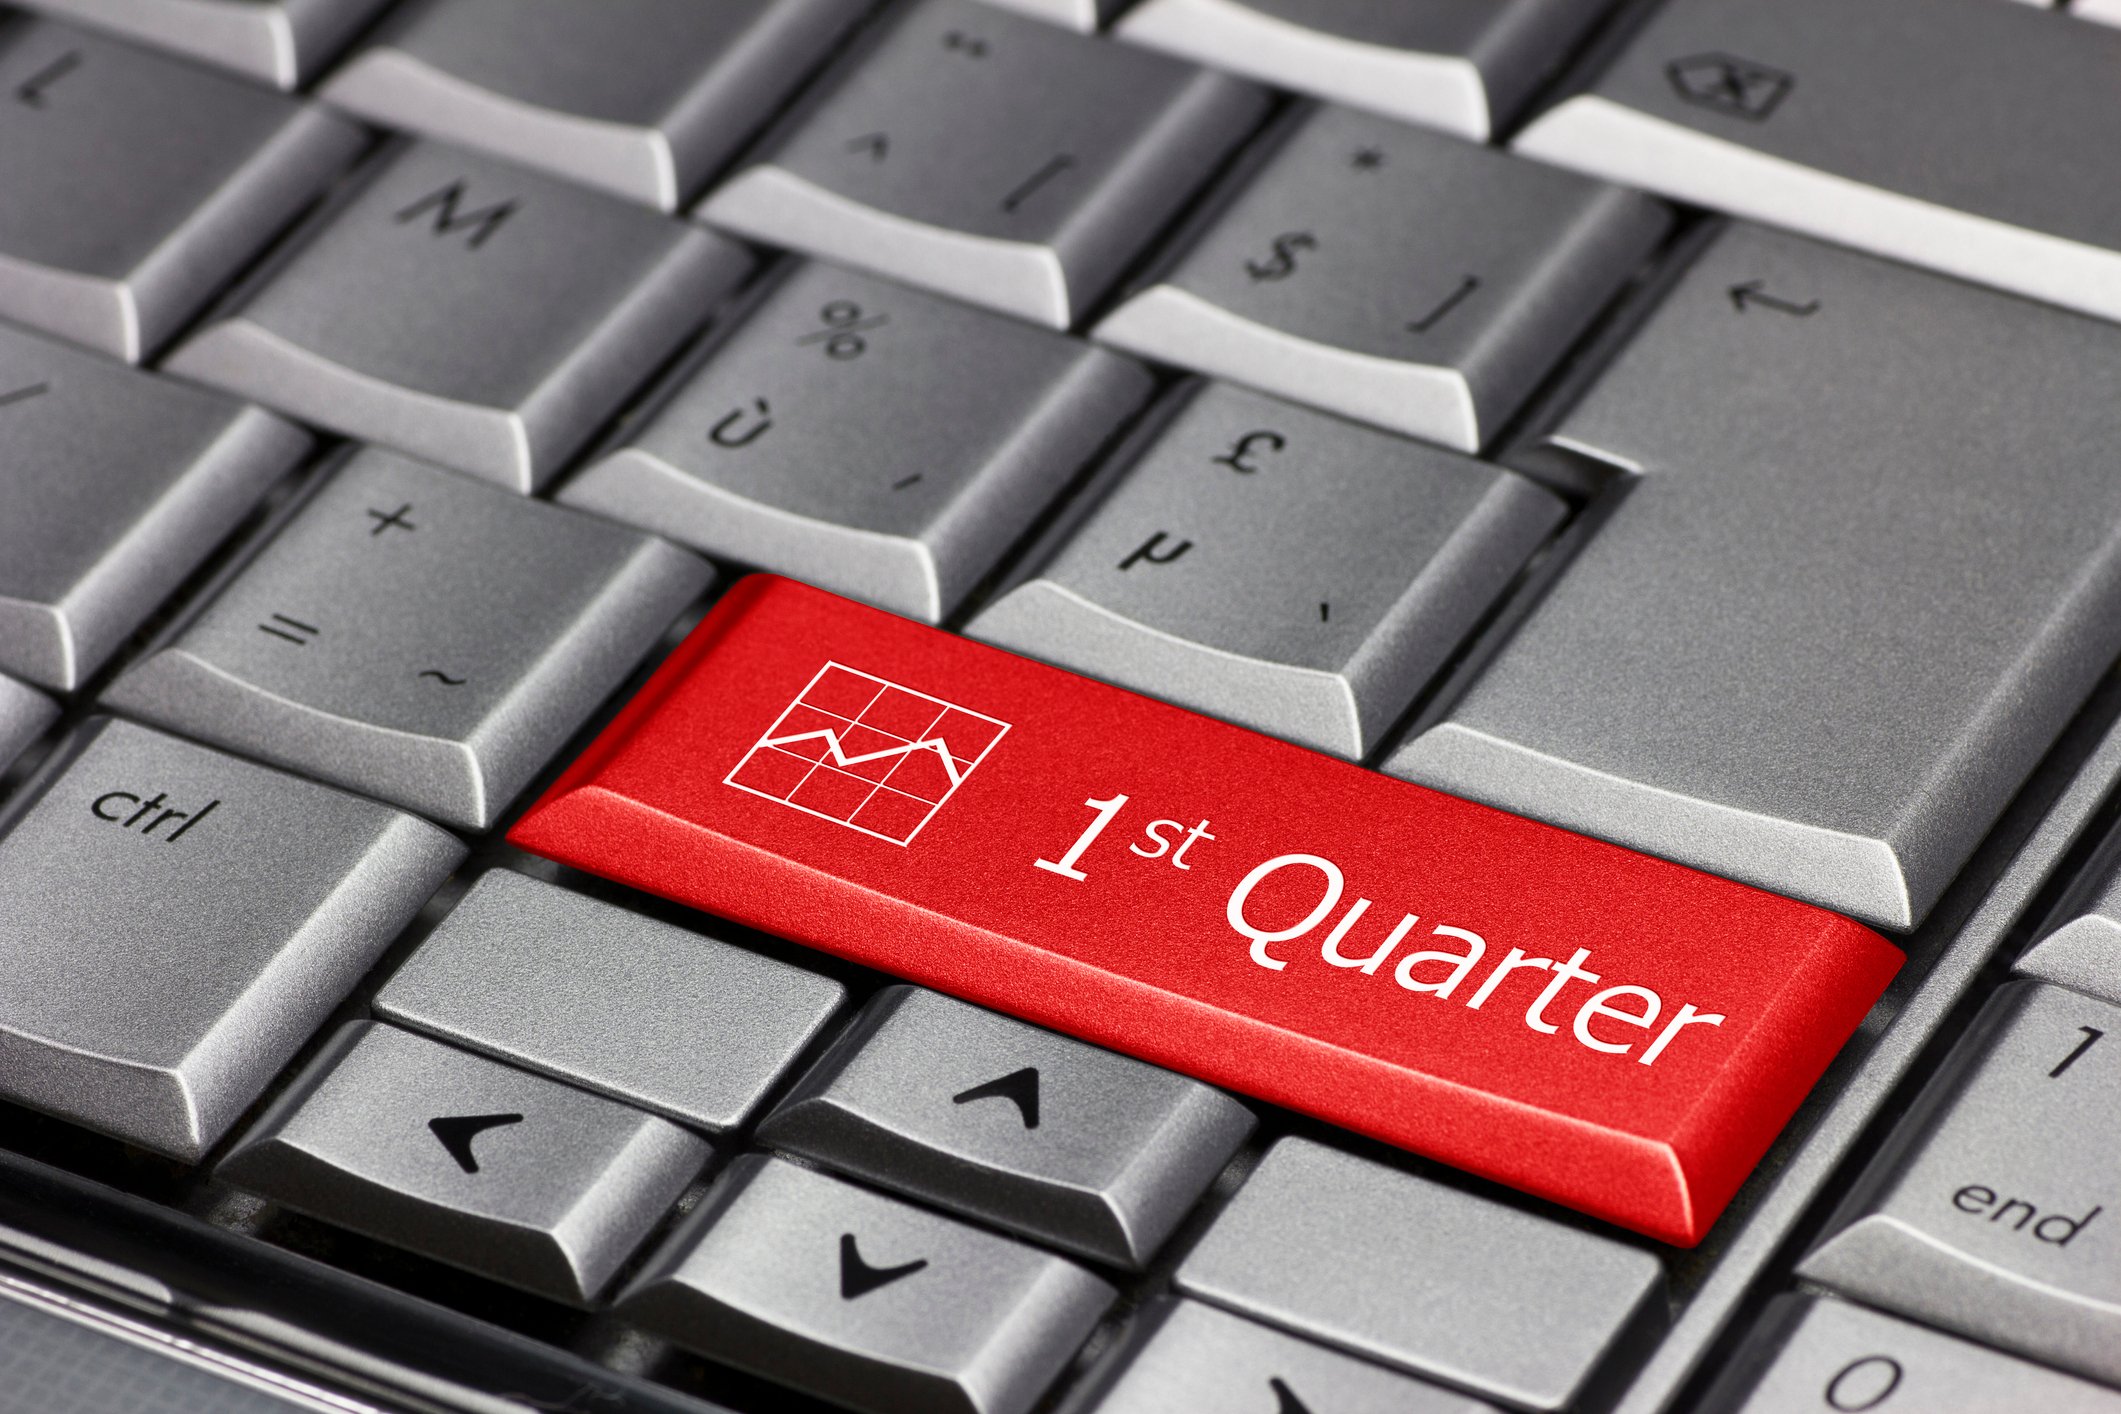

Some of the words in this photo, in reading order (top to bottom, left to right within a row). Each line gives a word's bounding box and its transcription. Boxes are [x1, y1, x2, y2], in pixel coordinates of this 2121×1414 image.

[394, 176, 517, 250] M
[1244, 232, 1318, 282] $
[796, 300, 889, 361] %
[708, 398, 772, 449] ù
[1212, 430, 1286, 475] £
[367, 503, 416, 537] +
[257, 612, 320, 647] =
[90, 790, 221, 844] ctrl
[1033, 793, 1216, 882] 1st
[1225, 853, 1726, 1067] Quarter
[2048, 1025, 2105, 1079] 1
[1950, 1183, 2104, 1248] end
